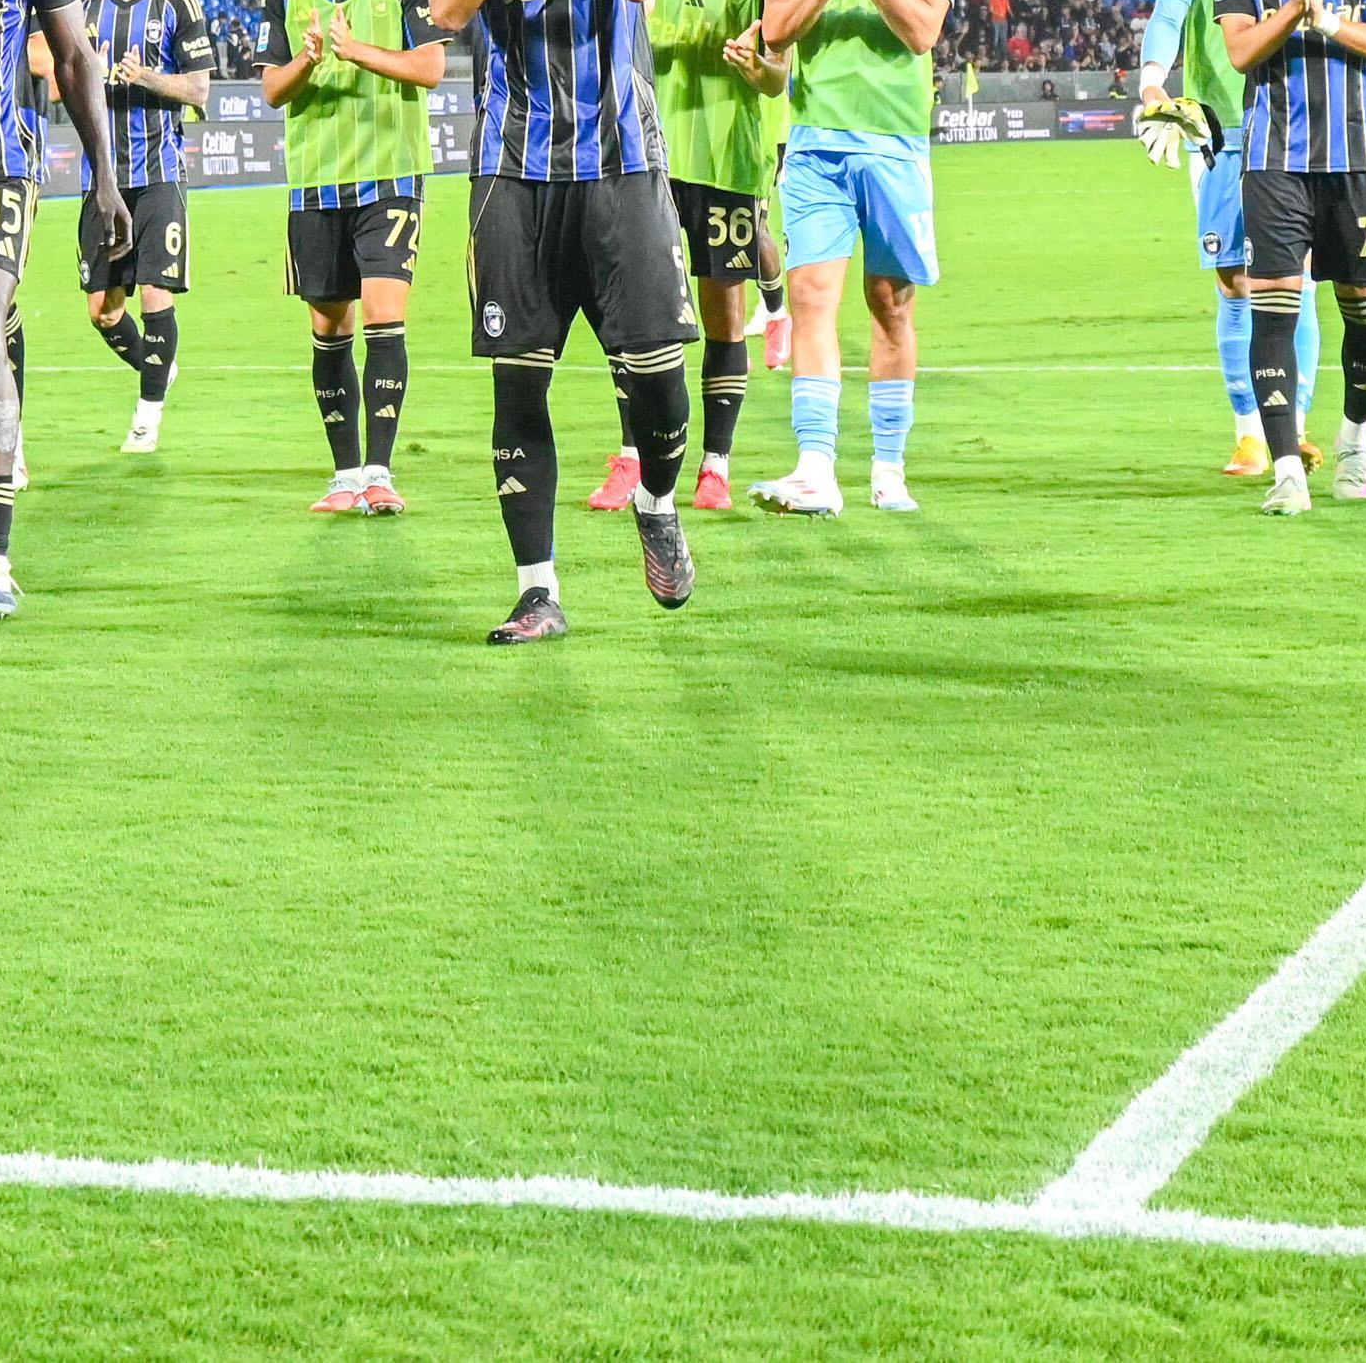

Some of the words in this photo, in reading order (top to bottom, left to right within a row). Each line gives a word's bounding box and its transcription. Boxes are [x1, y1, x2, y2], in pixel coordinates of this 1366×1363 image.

[164, 221, 182, 257] 6
[384, 208, 420, 254] 72
[707, 205, 754, 248] 36
[374, 378, 404, 390] PISA
[1255, 367, 1286, 379] PISA
